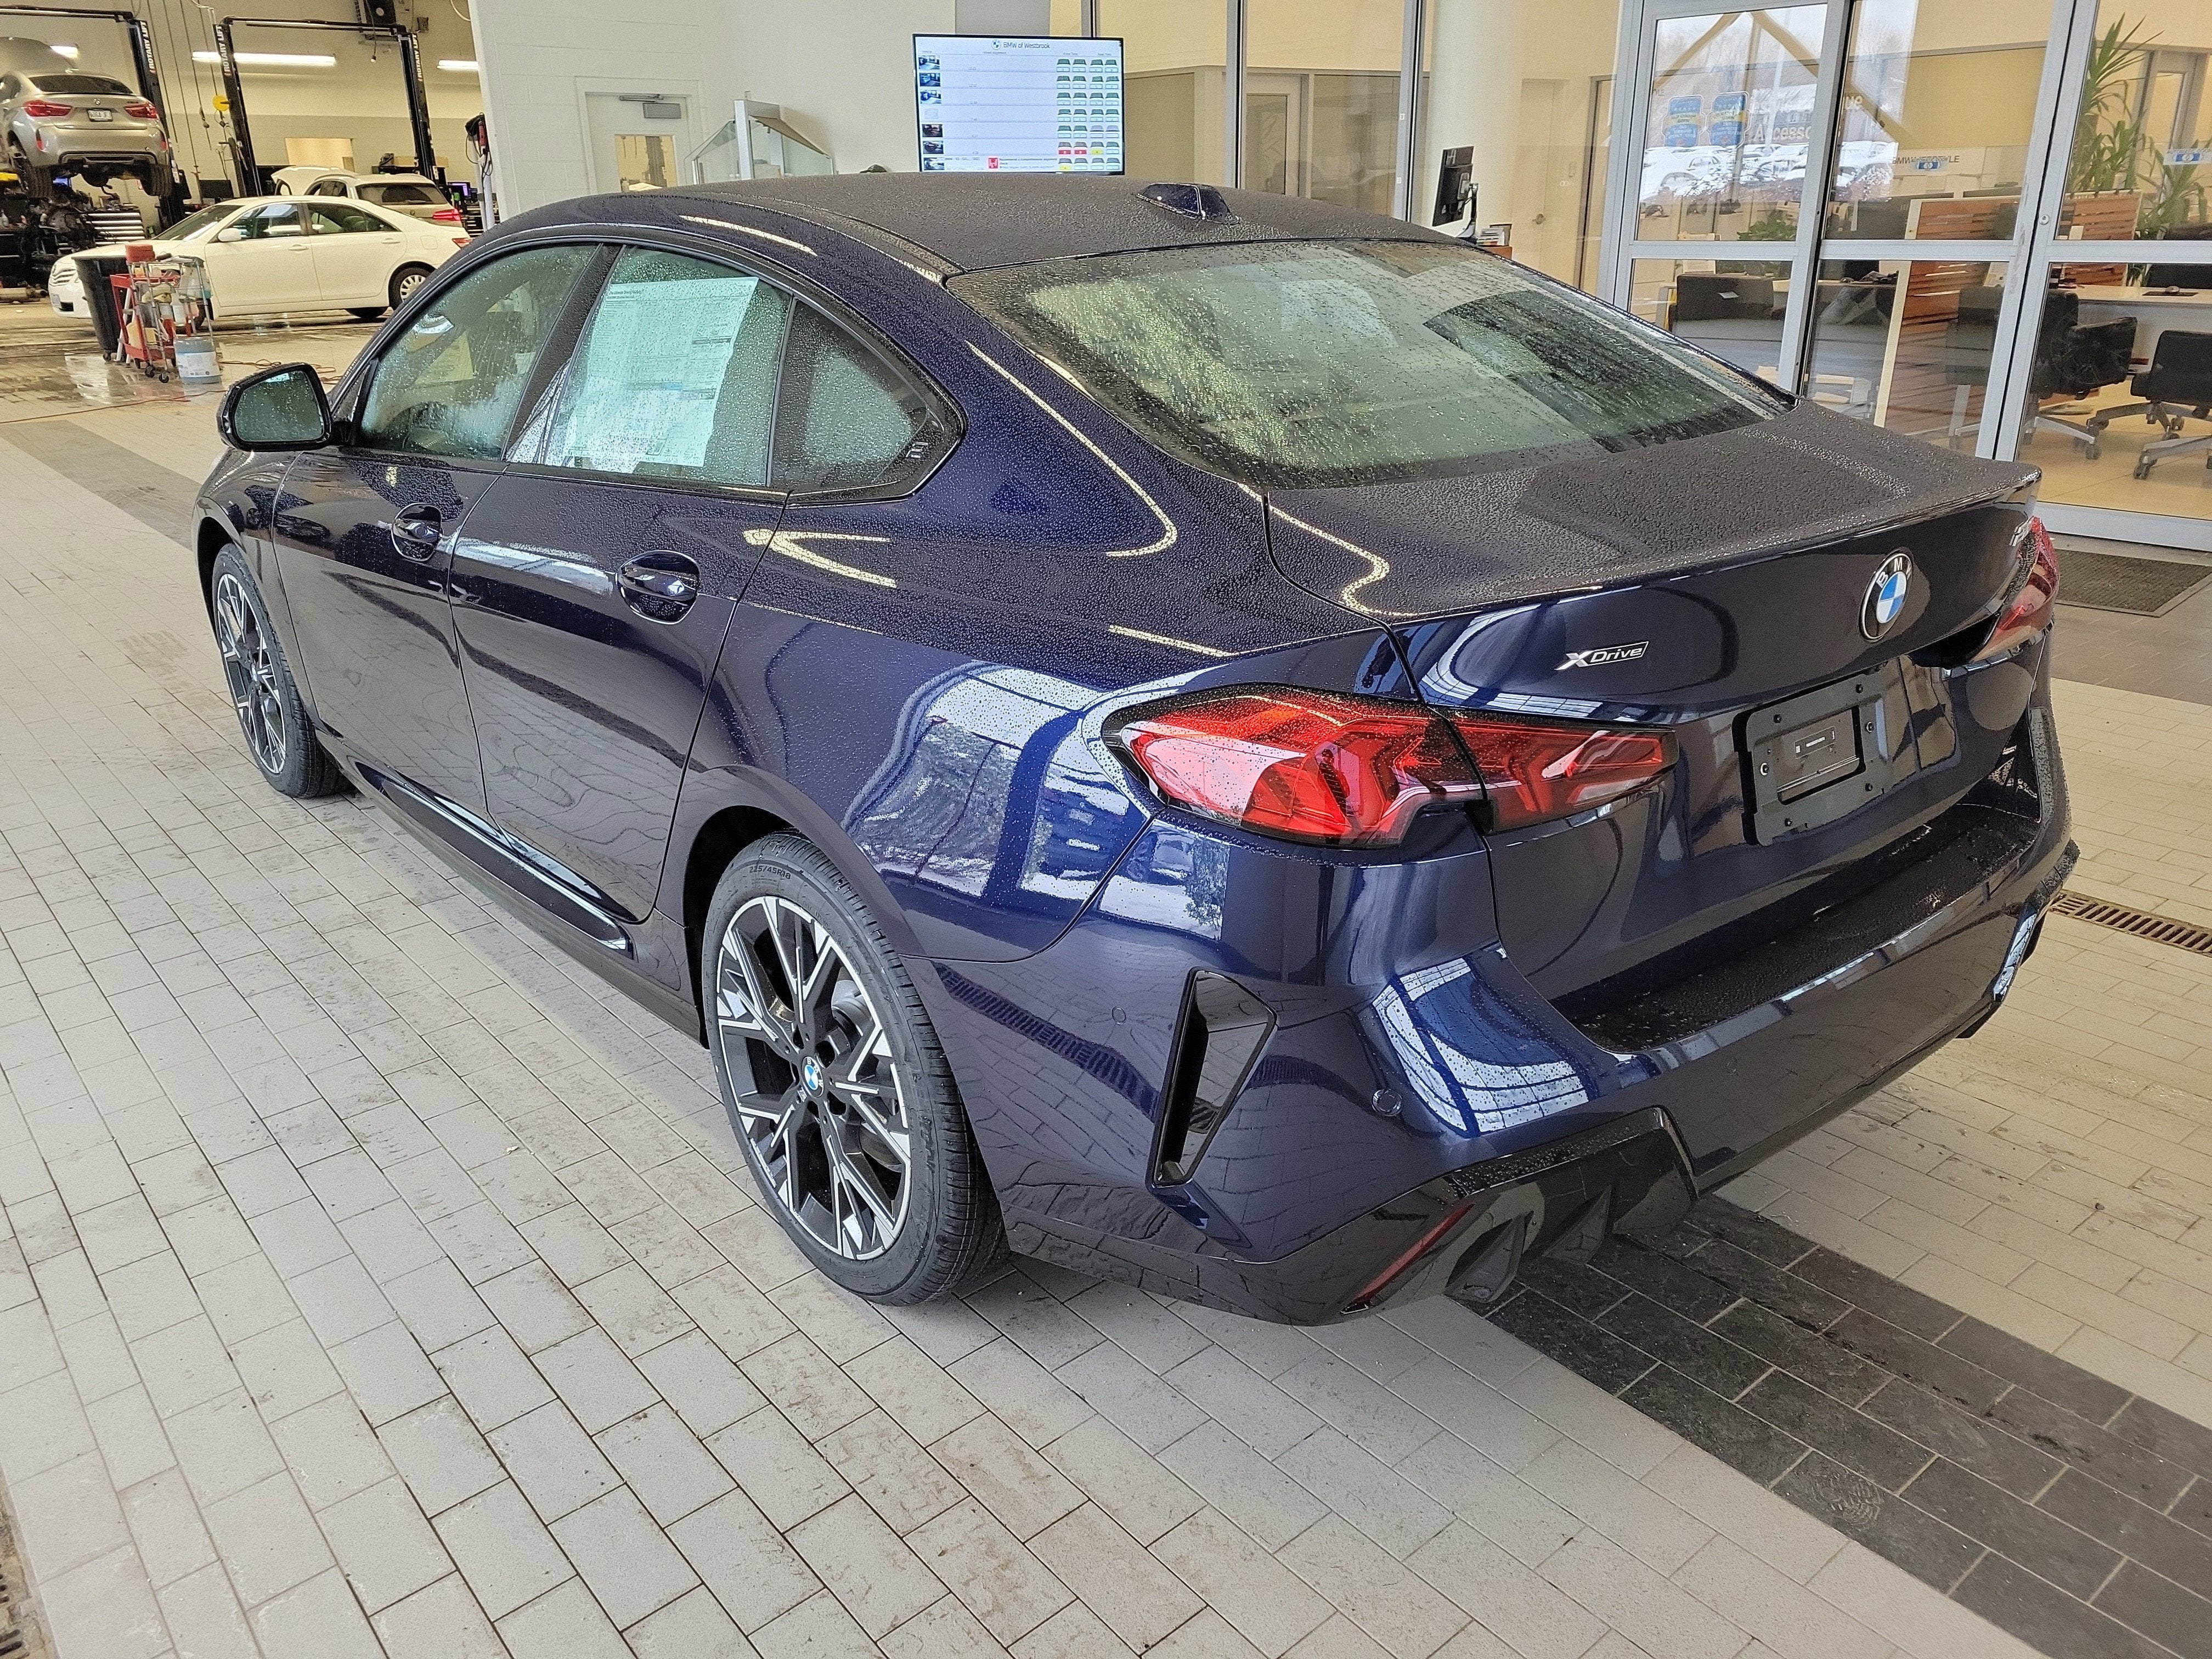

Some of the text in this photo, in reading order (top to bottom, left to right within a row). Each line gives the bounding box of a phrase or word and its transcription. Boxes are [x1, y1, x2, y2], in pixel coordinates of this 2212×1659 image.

[144, 38, 155, 69] ROTARY
[216, 24, 231, 72] ROTARY LIFT
[414, 50, 423, 78] ROTARY
[1876, 557, 1913, 589] BMW
[749, 865, 792, 880] 225/45R18
[806, 1058, 824, 1088] BMW
